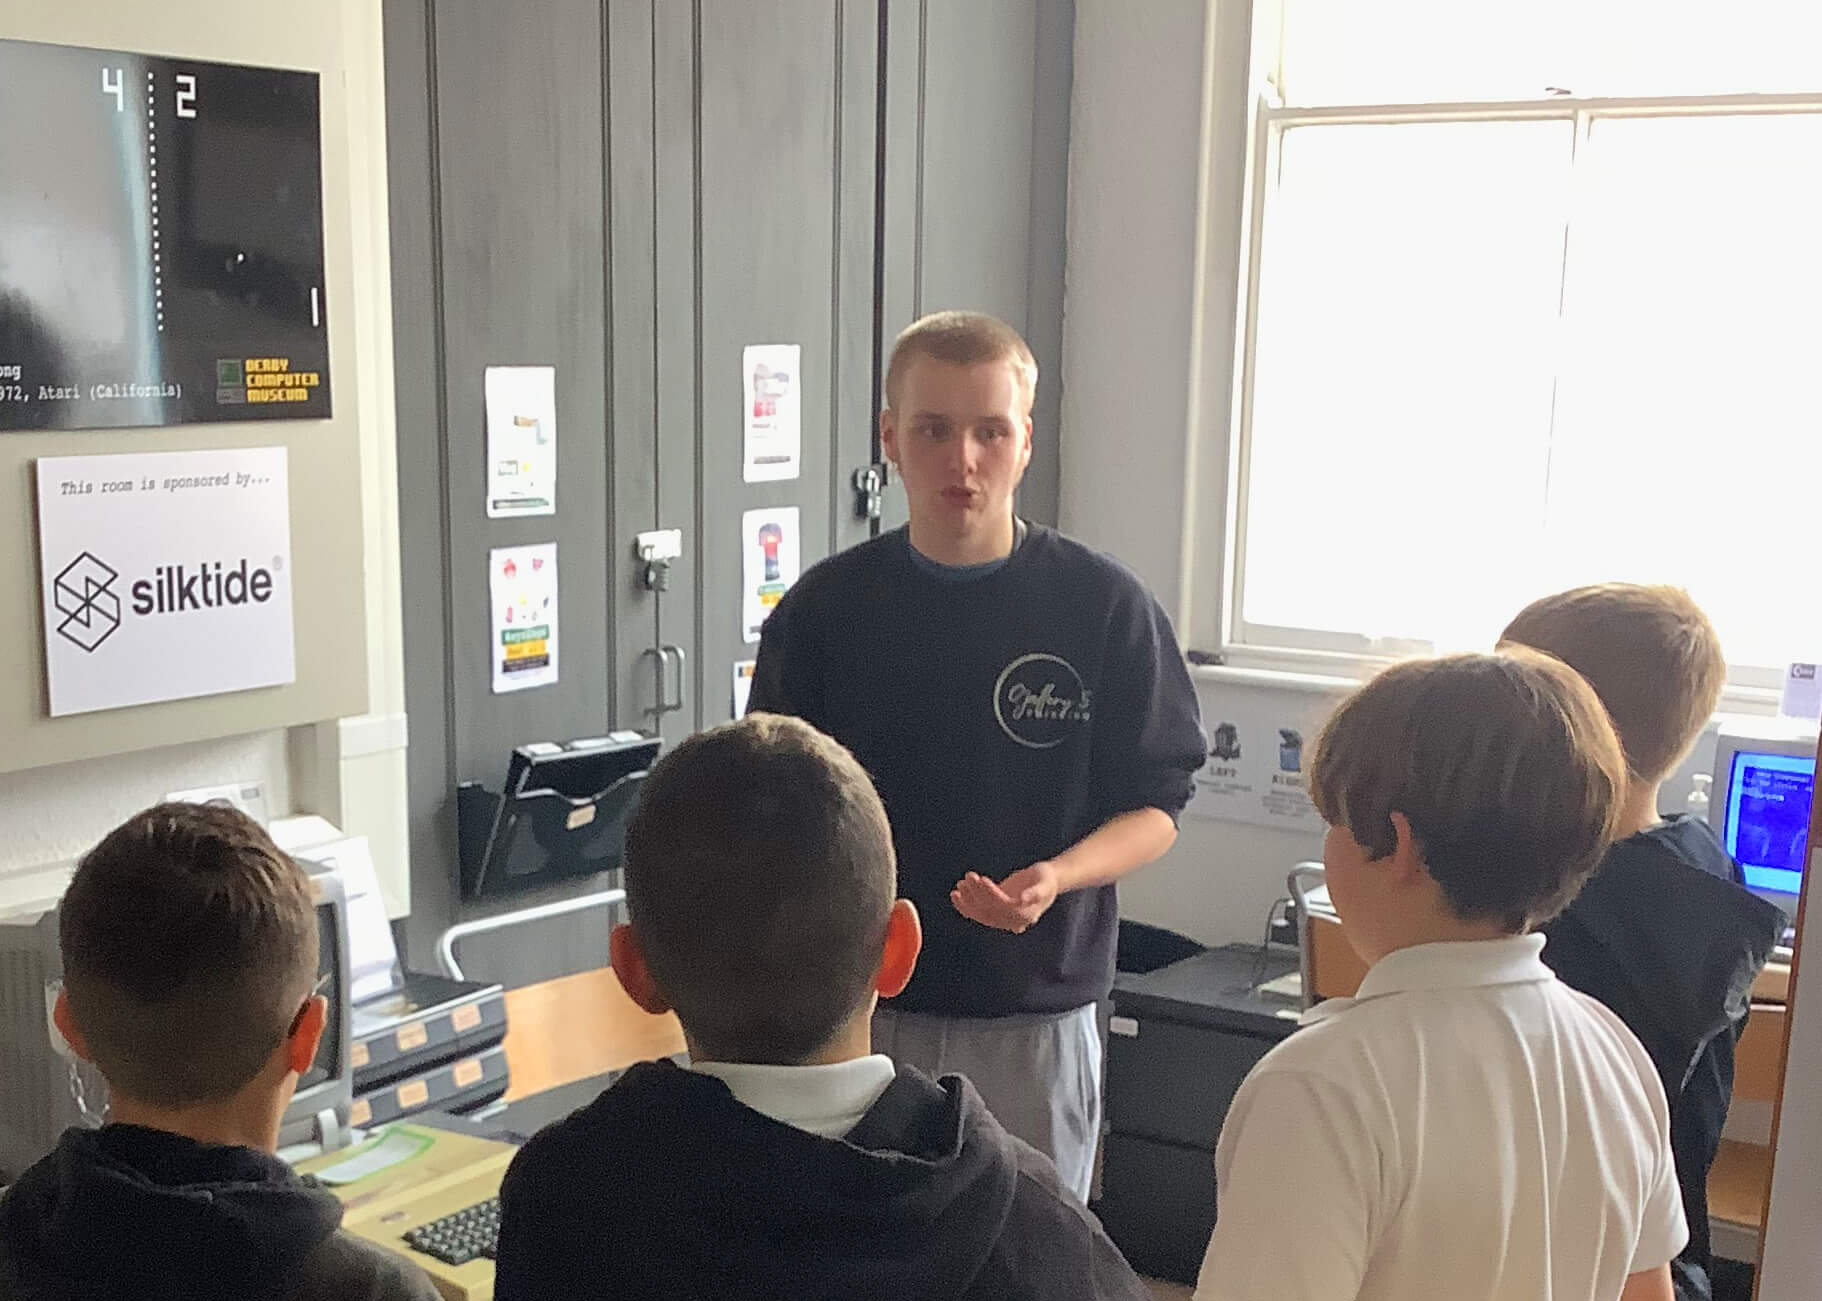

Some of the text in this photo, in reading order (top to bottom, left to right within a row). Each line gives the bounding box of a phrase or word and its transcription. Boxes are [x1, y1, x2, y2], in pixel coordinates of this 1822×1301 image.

[102, 68, 197, 118] 4 2
[245, 358, 289, 373] DERBY
[246, 373, 320, 387] COMPUTER
[38, 384, 80, 400] Atari
[90, 383, 182, 401] (California)
[247, 388, 309, 403] MUSEUM
[61, 471, 270, 495] This room is sponsored by...
[132, 558, 272, 615] silktide
